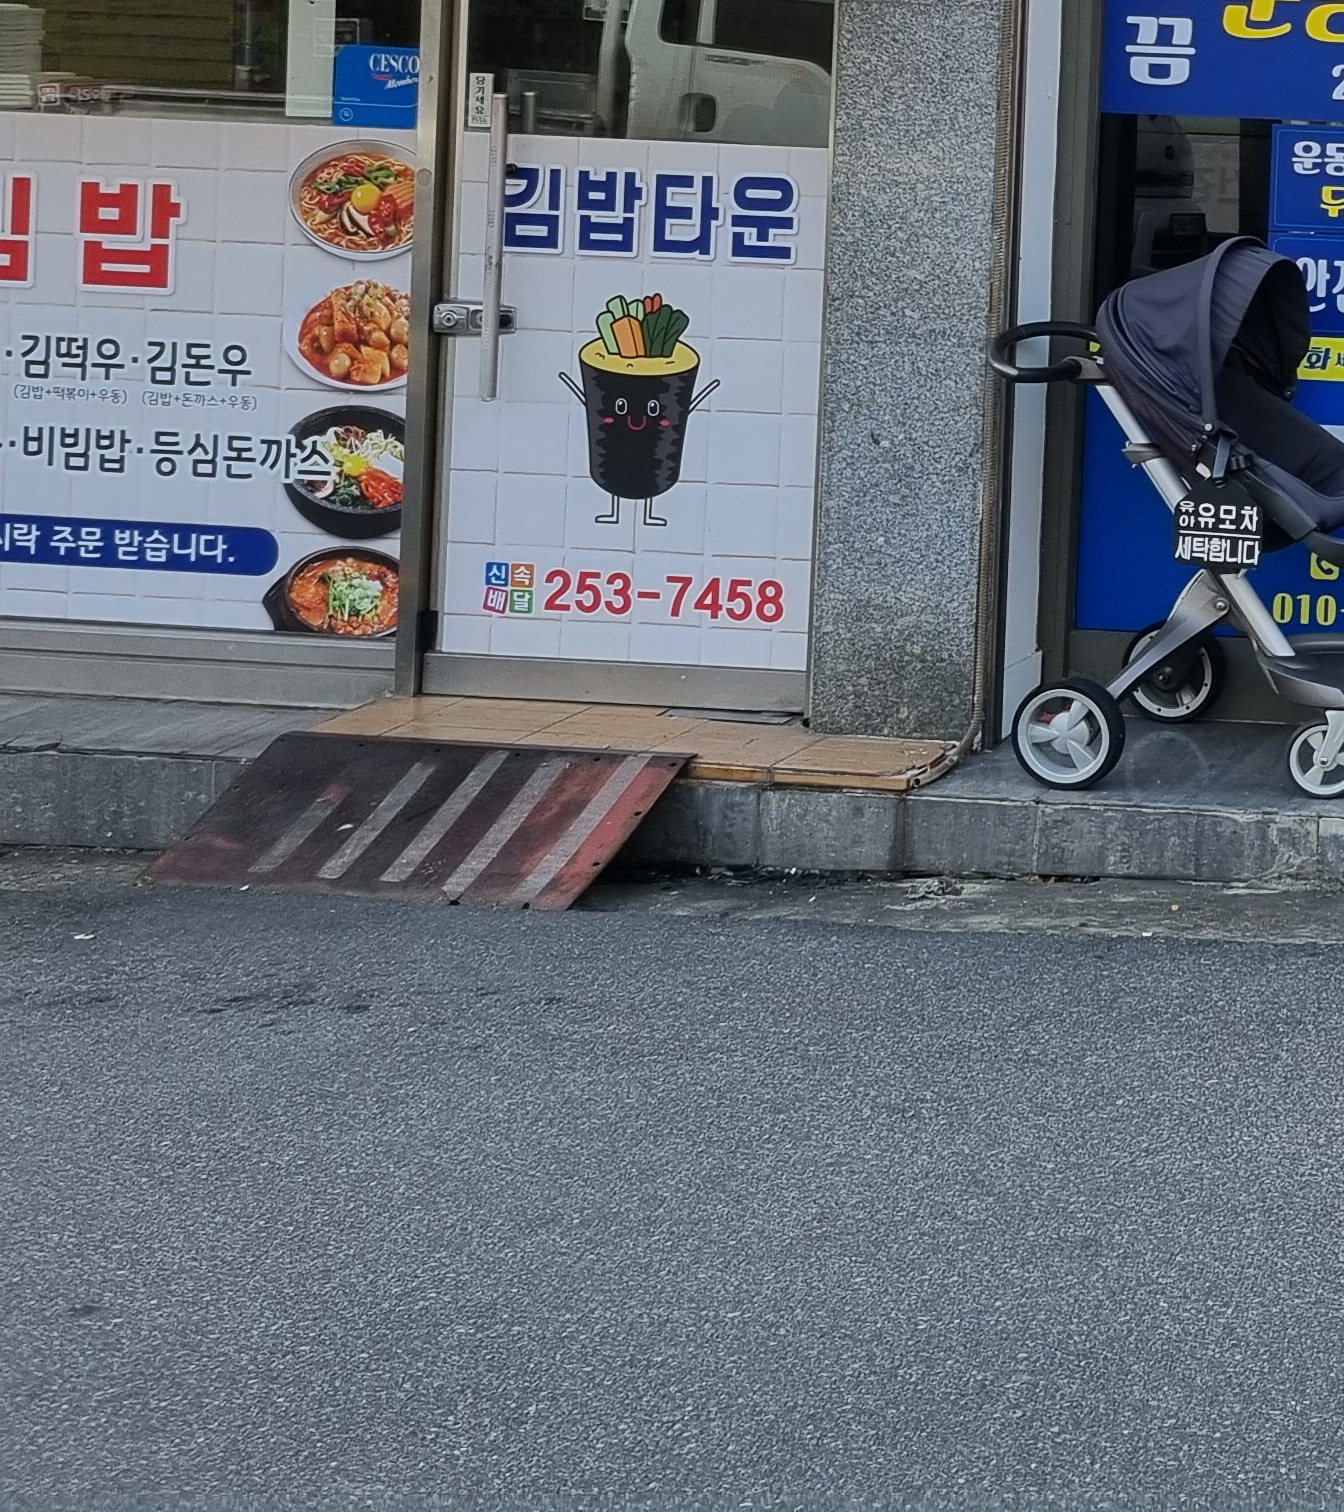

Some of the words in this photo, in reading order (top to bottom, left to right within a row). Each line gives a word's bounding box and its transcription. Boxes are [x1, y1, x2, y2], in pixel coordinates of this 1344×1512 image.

[369, 53, 421, 74] CESCO
[504, 166, 799, 261] 김밥타운
[142, 390, 258, 412] (김밥+돈까스+우동)
[1198, 504, 1259, 533] 유모차
[50, 525, 105, 559] 주문
[114, 529, 236, 565] 받습니다.
[1175, 535, 1261, 567] 세탁합니다
[488, 565, 532, 586] 신속
[487, 589, 531, 612] 배달
[544, 569, 785, 622] 253-7458
